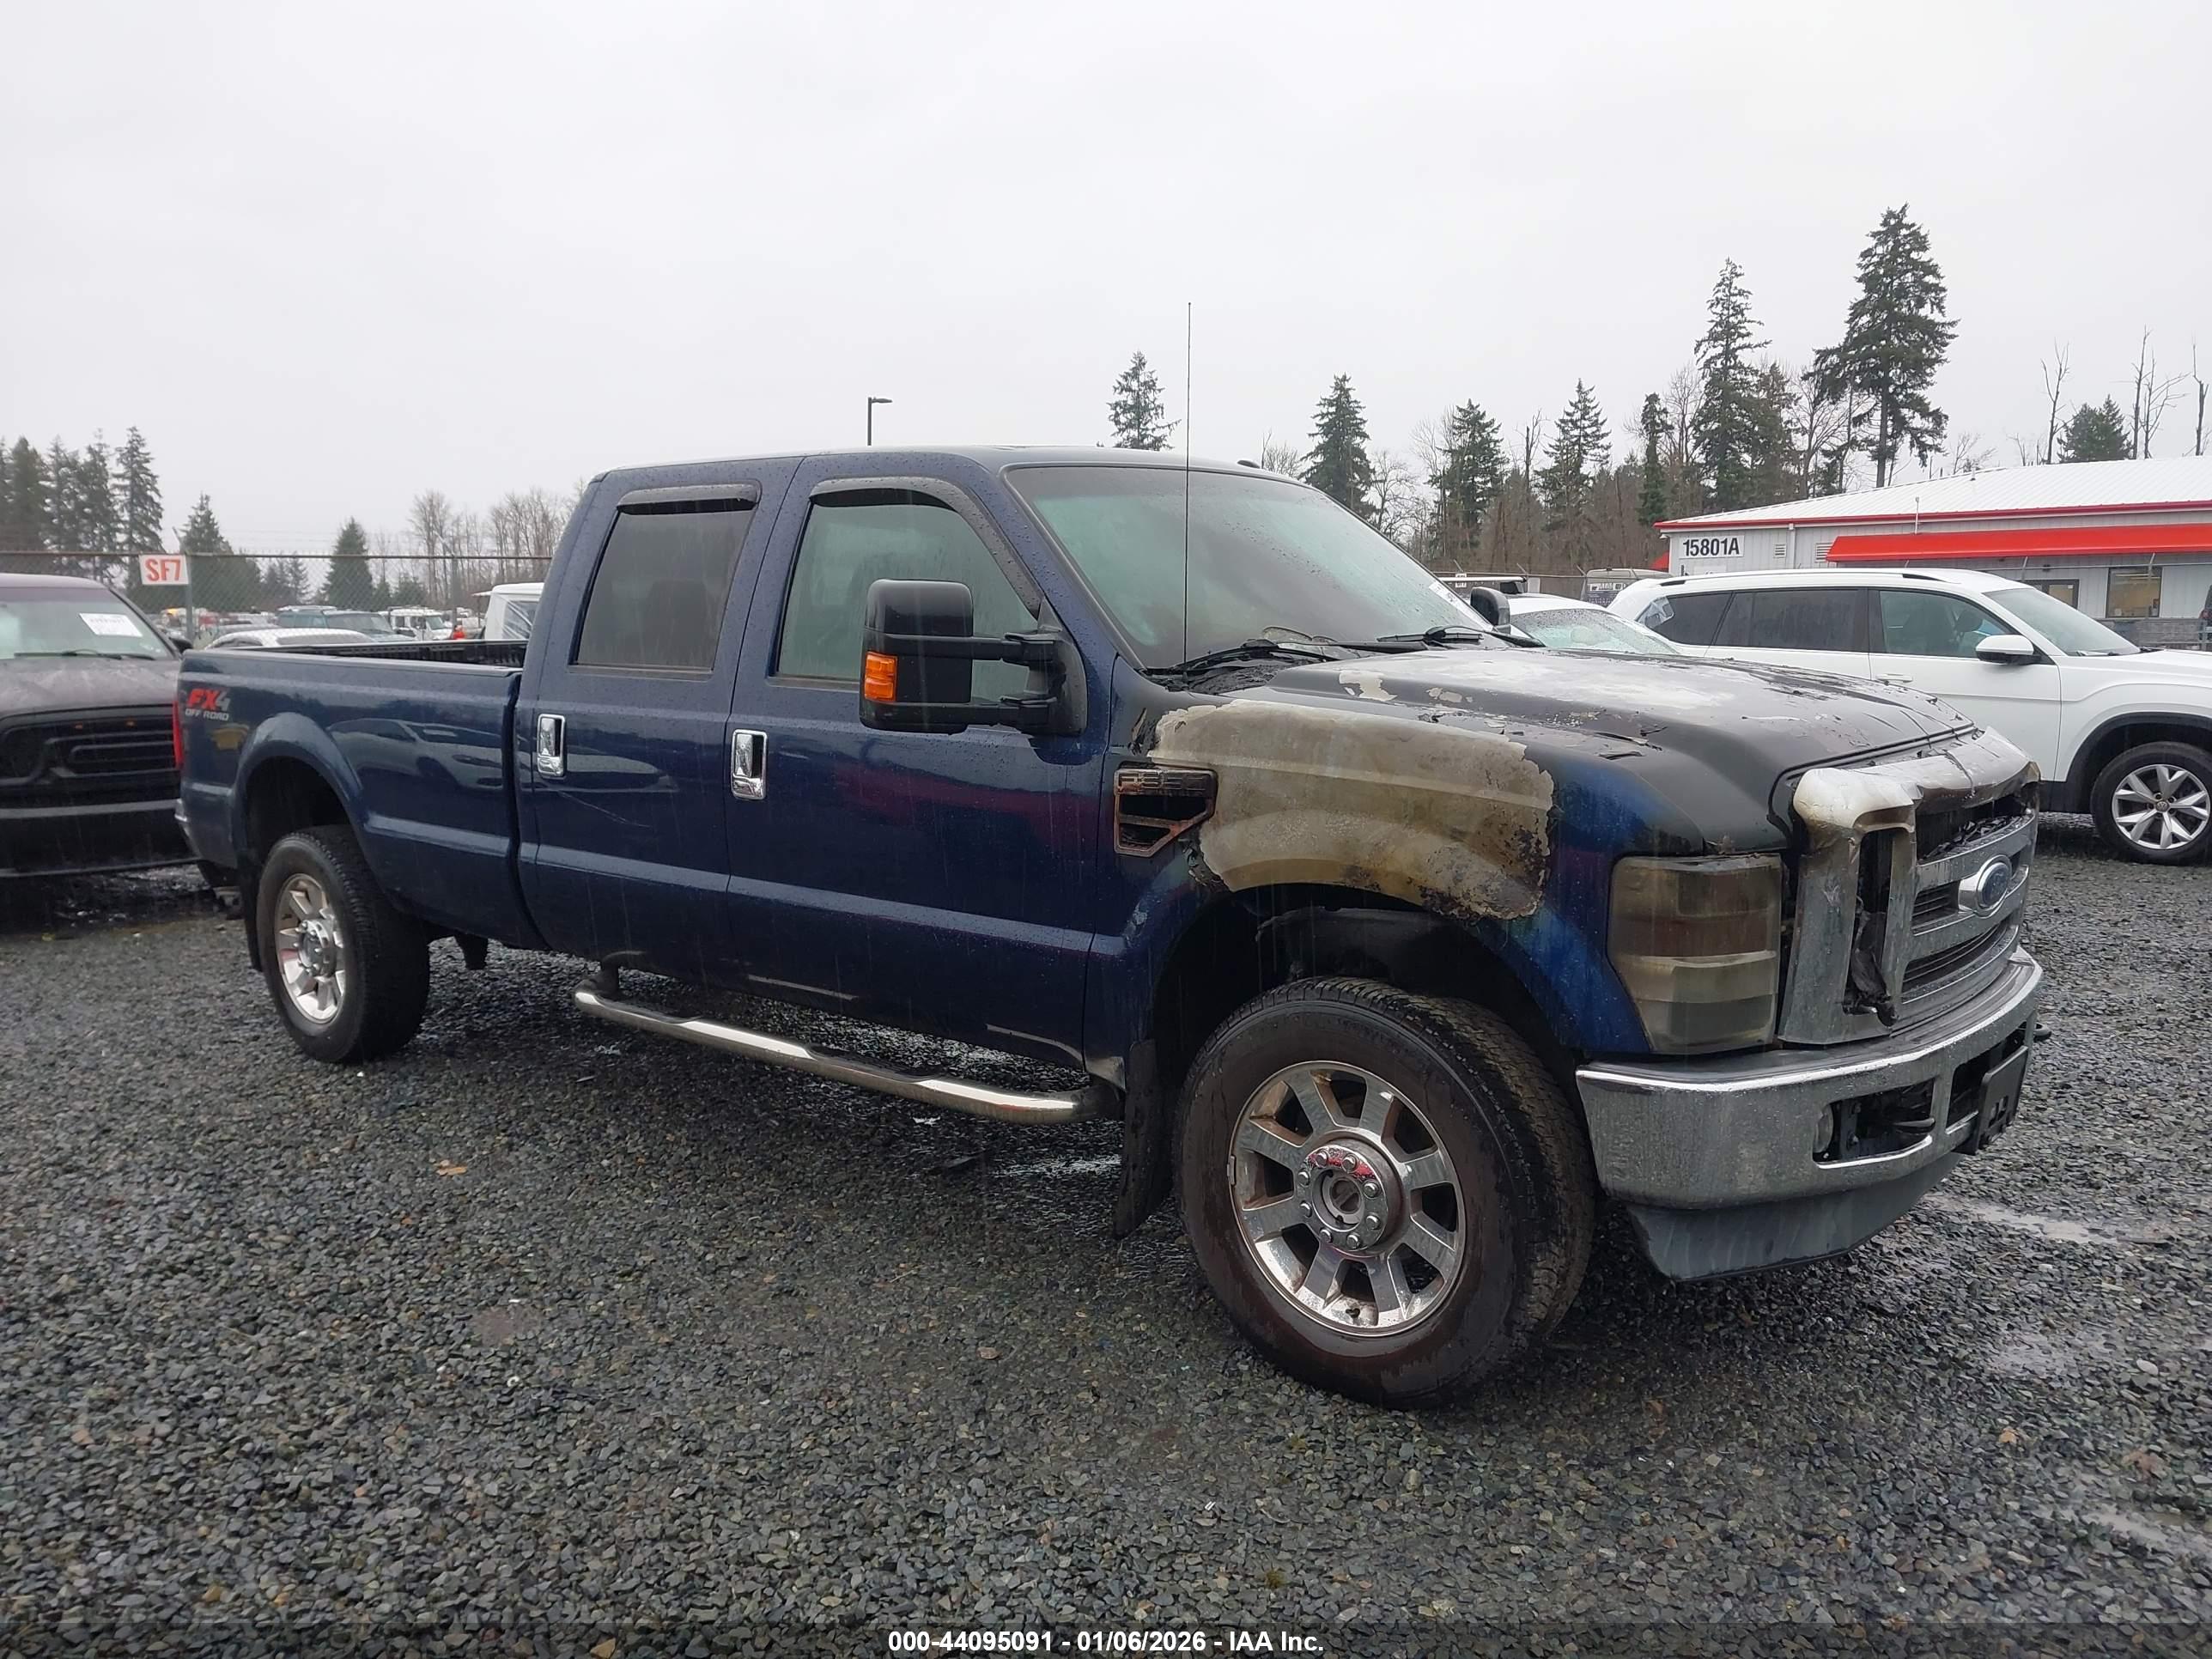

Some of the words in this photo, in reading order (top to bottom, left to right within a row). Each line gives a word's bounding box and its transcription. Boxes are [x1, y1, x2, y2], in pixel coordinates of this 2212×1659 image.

[1682, 537, 1741, 557] 15801A
[144, 558, 181, 582] SF7
[186, 688, 231, 712] FX4
[185, 708, 201, 717] OFF
[203, 711, 229, 720] ROAD
